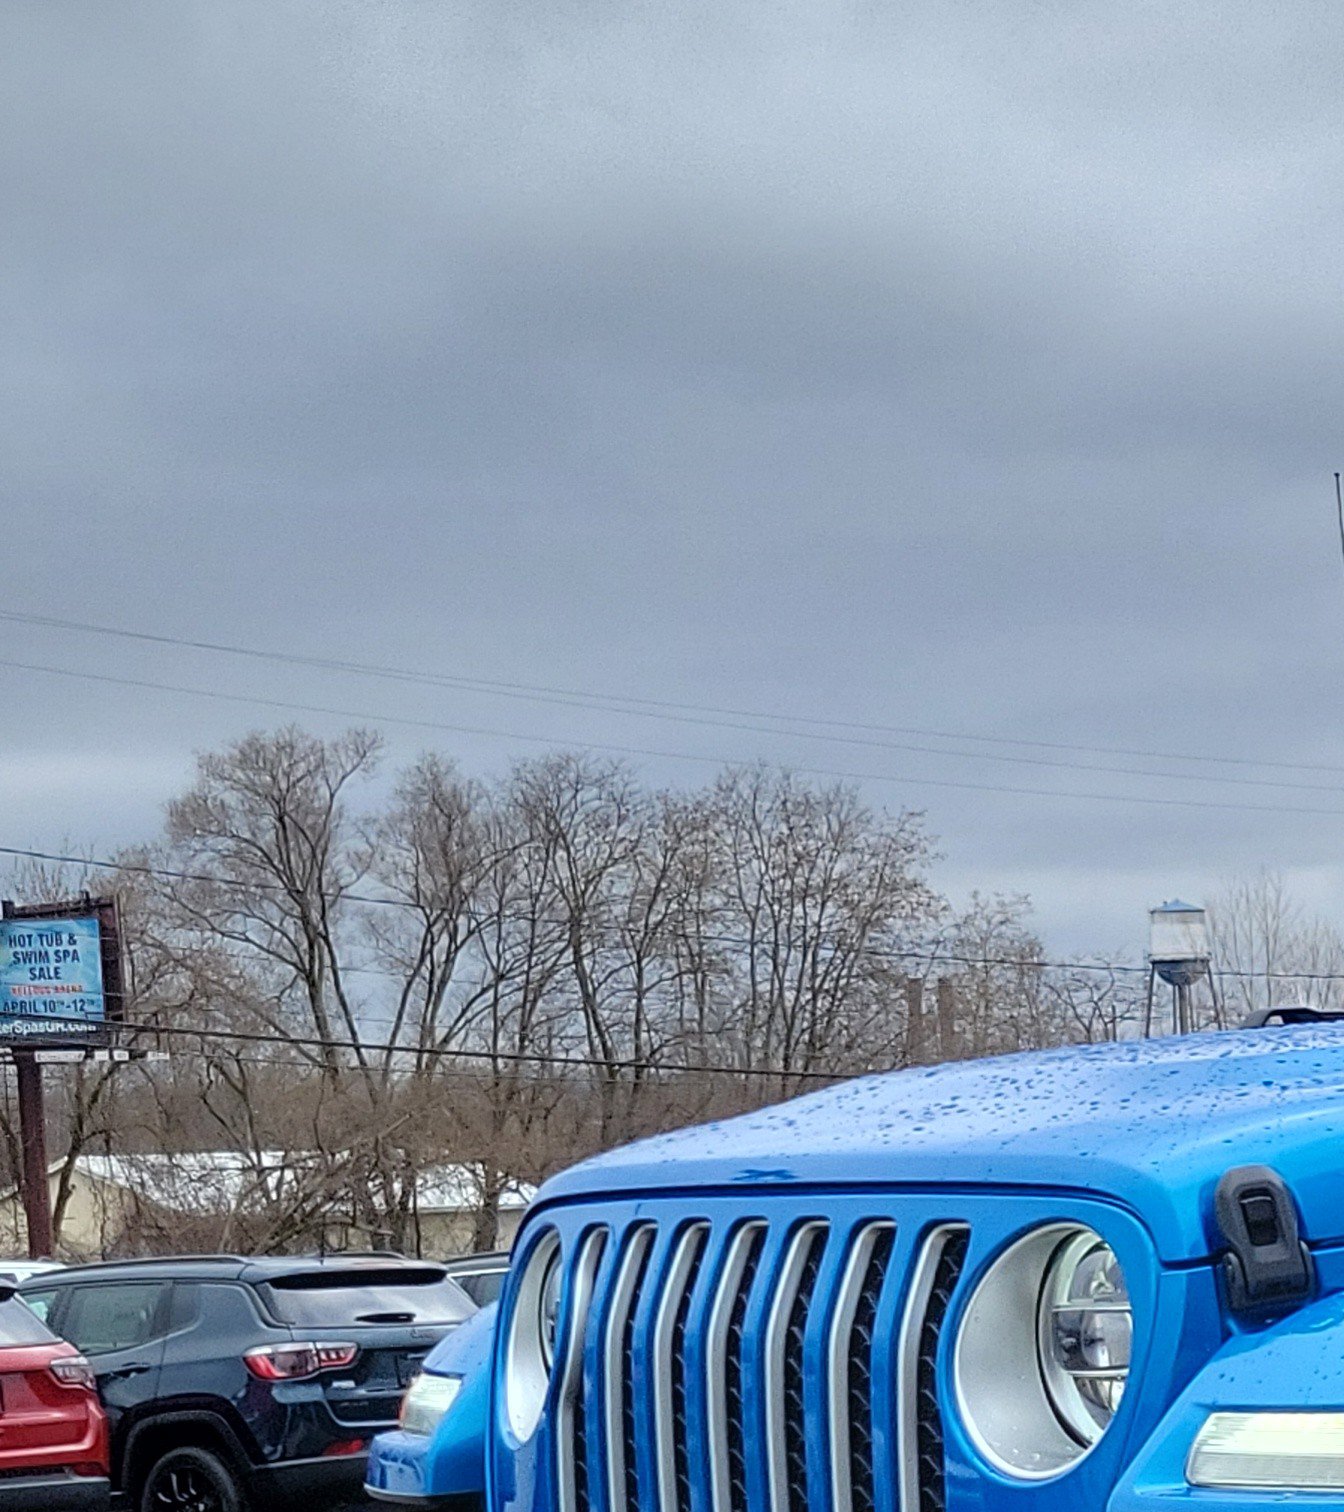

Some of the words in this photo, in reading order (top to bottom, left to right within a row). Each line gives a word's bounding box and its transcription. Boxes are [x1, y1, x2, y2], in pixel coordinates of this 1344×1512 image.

[8, 934, 33, 948] HOT
[37, 931, 63, 947] TUB
[68, 932, 77, 946] &
[12, 950, 50, 965] SWIM
[54, 949, 80, 963] SPA
[29, 966, 62, 981] SALE
[3, 1000, 40, 1013] APRIL
